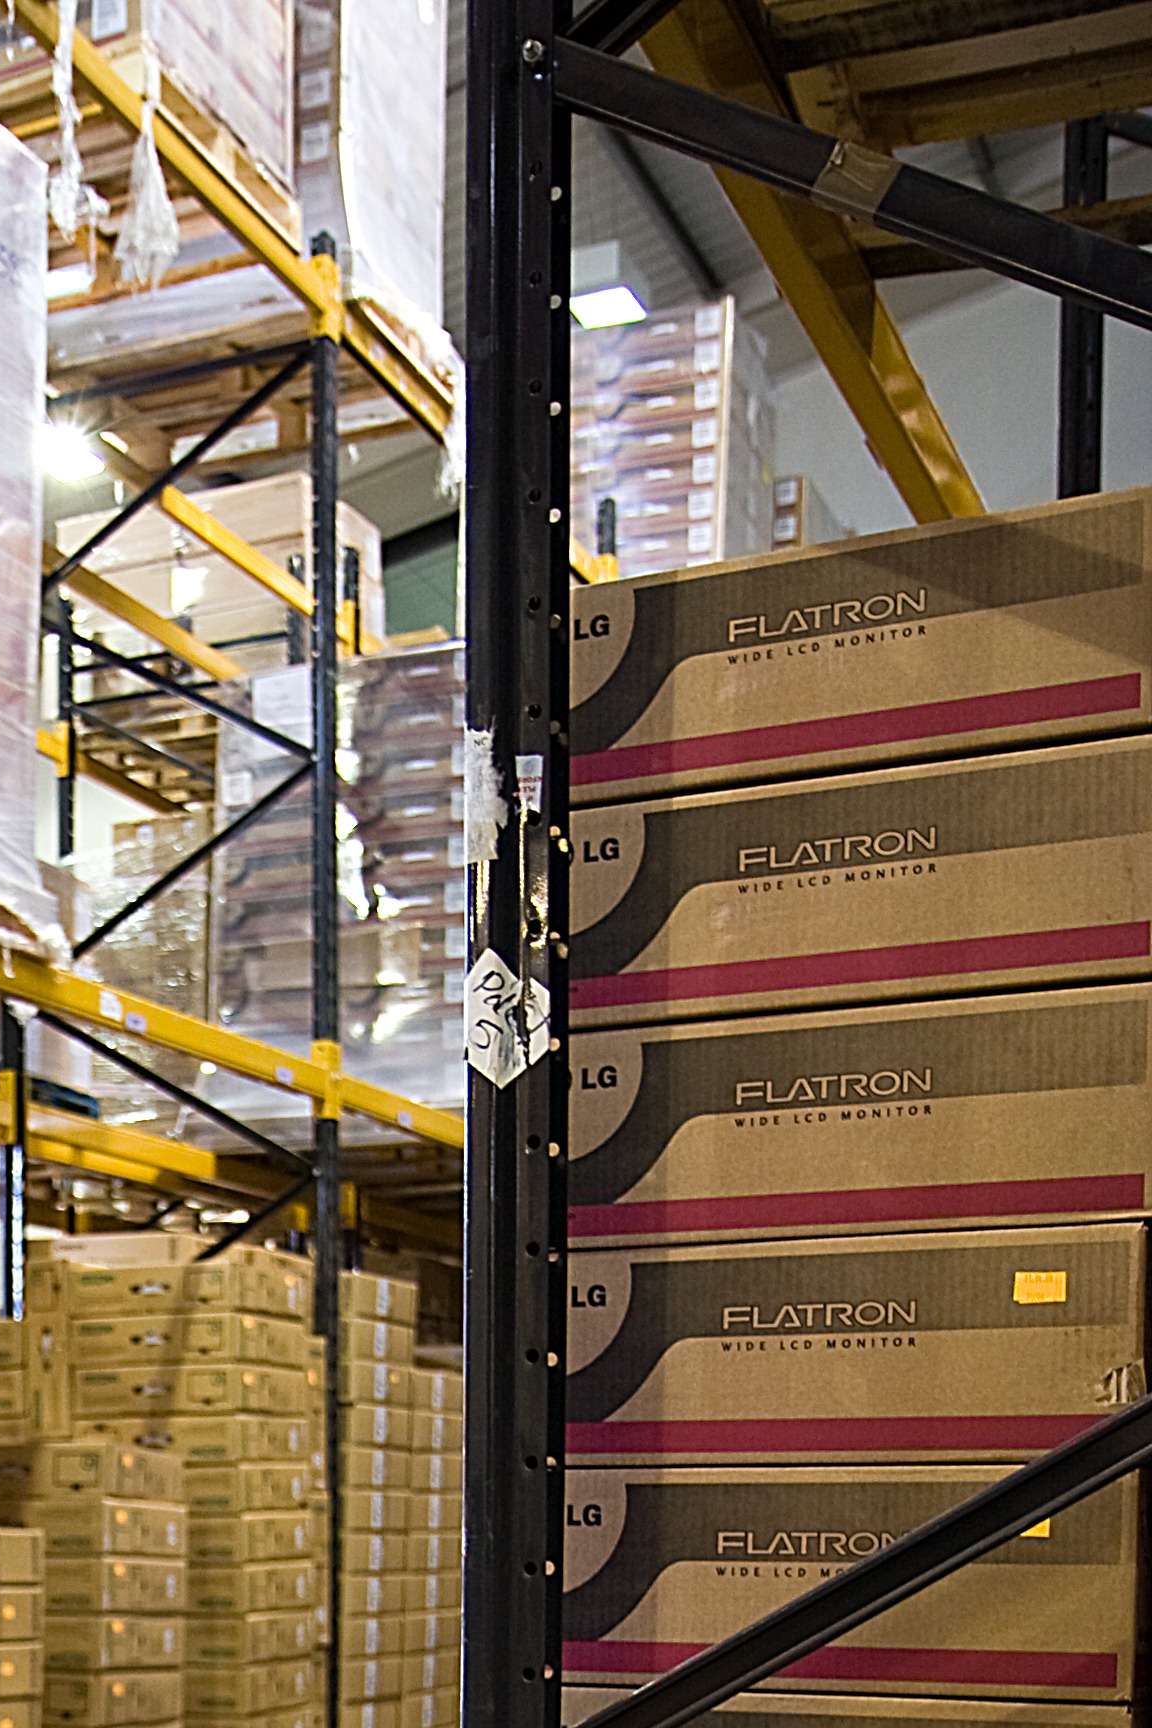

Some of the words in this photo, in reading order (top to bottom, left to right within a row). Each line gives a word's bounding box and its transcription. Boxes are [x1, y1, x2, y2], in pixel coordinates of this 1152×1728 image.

[574, 614, 610, 641] LG
[728, 588, 928, 643] FLATRON
[728, 648, 774, 665] WIDE
[787, 642, 821, 657] LCD
[834, 625, 928, 649] MONITOR
[583, 837, 620, 862] LG
[738, 826, 937, 873] FLATRON
[737, 880, 783, 895] WIDE
[797, 874, 831, 888] LCD
[845, 862, 937, 884] MONITOR
[580, 1066, 618, 1091] LG
[735, 1068, 933, 1106] FLATRON
[735, 1114, 781, 1129] WIDE
[793, 1111, 827, 1124] LCD
[841, 1104, 933, 1121] MONITOR
[571, 1285, 607, 1308] LG
[722, 1300, 917, 1331] FLATRON
[722, 1339, 767, 1353] WIDE
[779, 1338, 812, 1351] LCD
[826, 1336, 917, 1350] MONITOR
[566, 1504, 602, 1526] LG
[716, 1566, 760, 1578] WIDE
[773, 1566, 806, 1579] LCD
